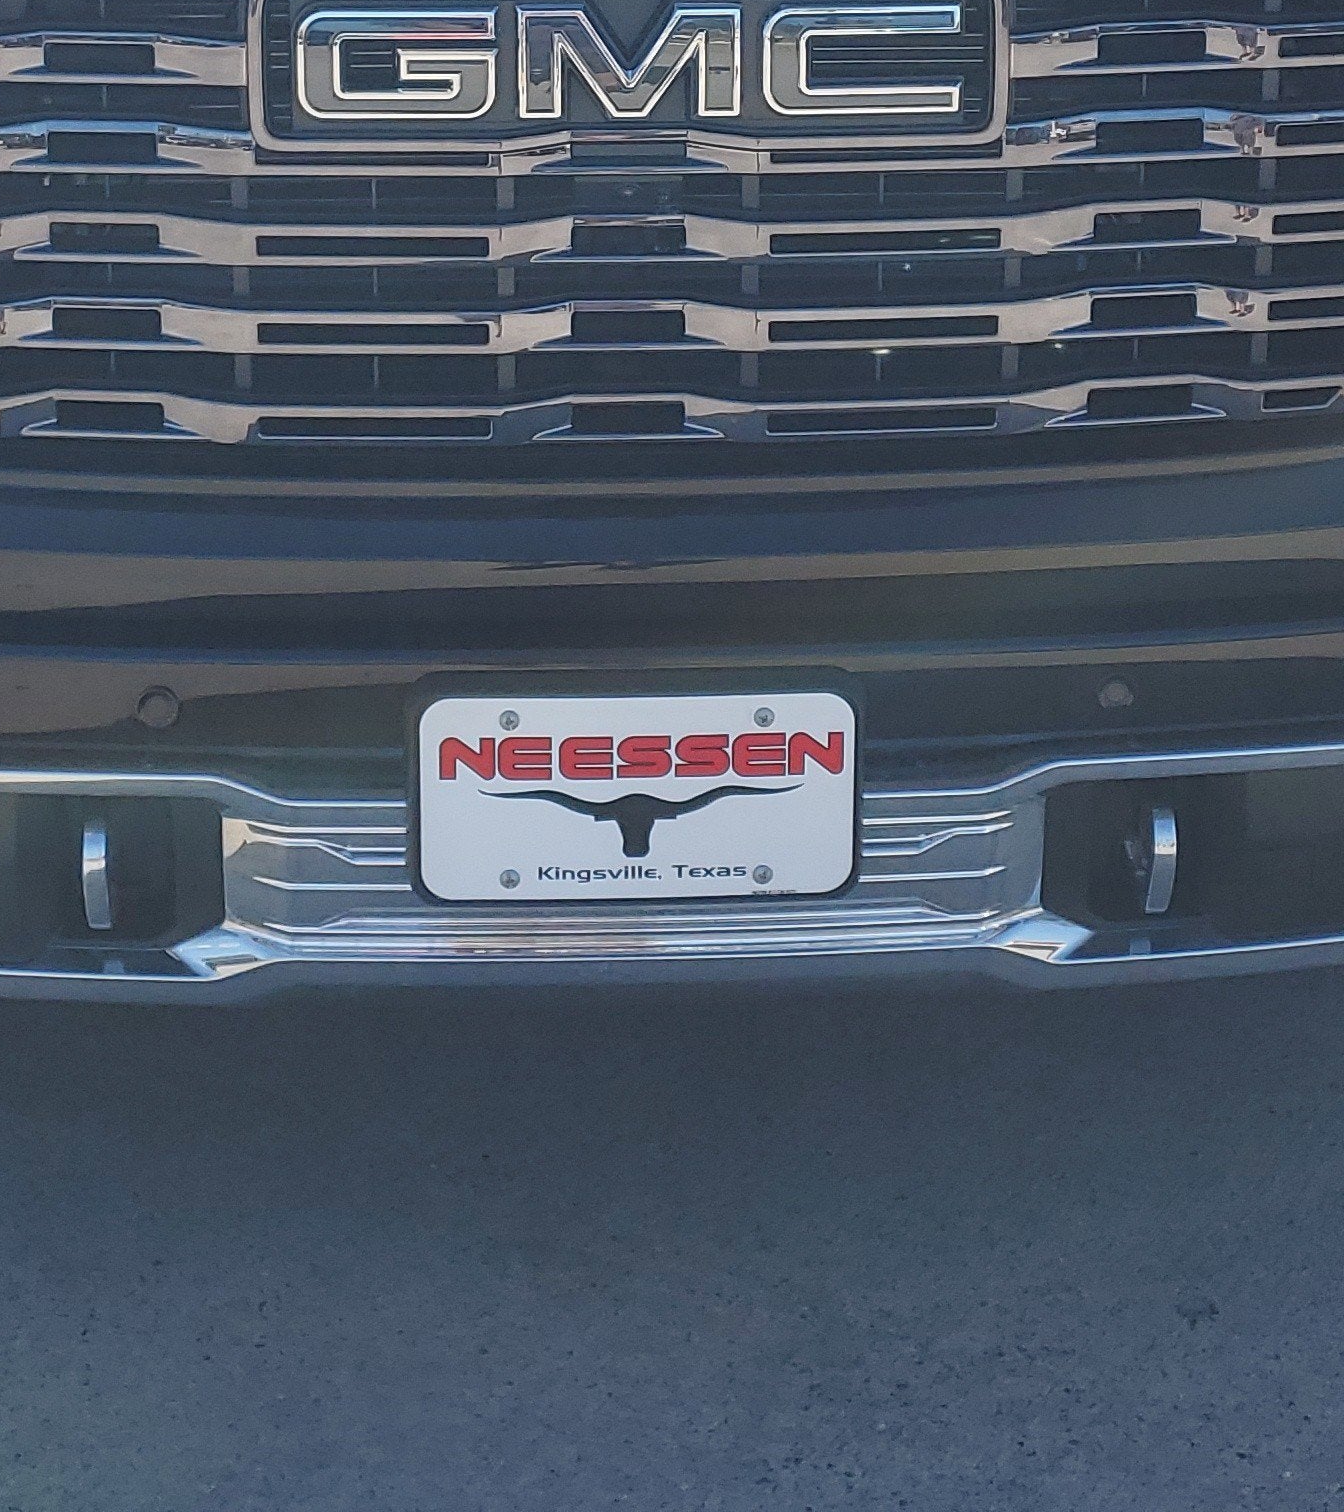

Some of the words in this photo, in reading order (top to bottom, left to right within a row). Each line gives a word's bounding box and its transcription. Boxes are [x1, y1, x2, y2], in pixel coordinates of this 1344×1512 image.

[295, 3, 963, 120] GMC
[438, 732, 845, 781] NEESSEN
[537, 865, 662, 883] Kingsville,
[672, 864, 747, 879] Texas
